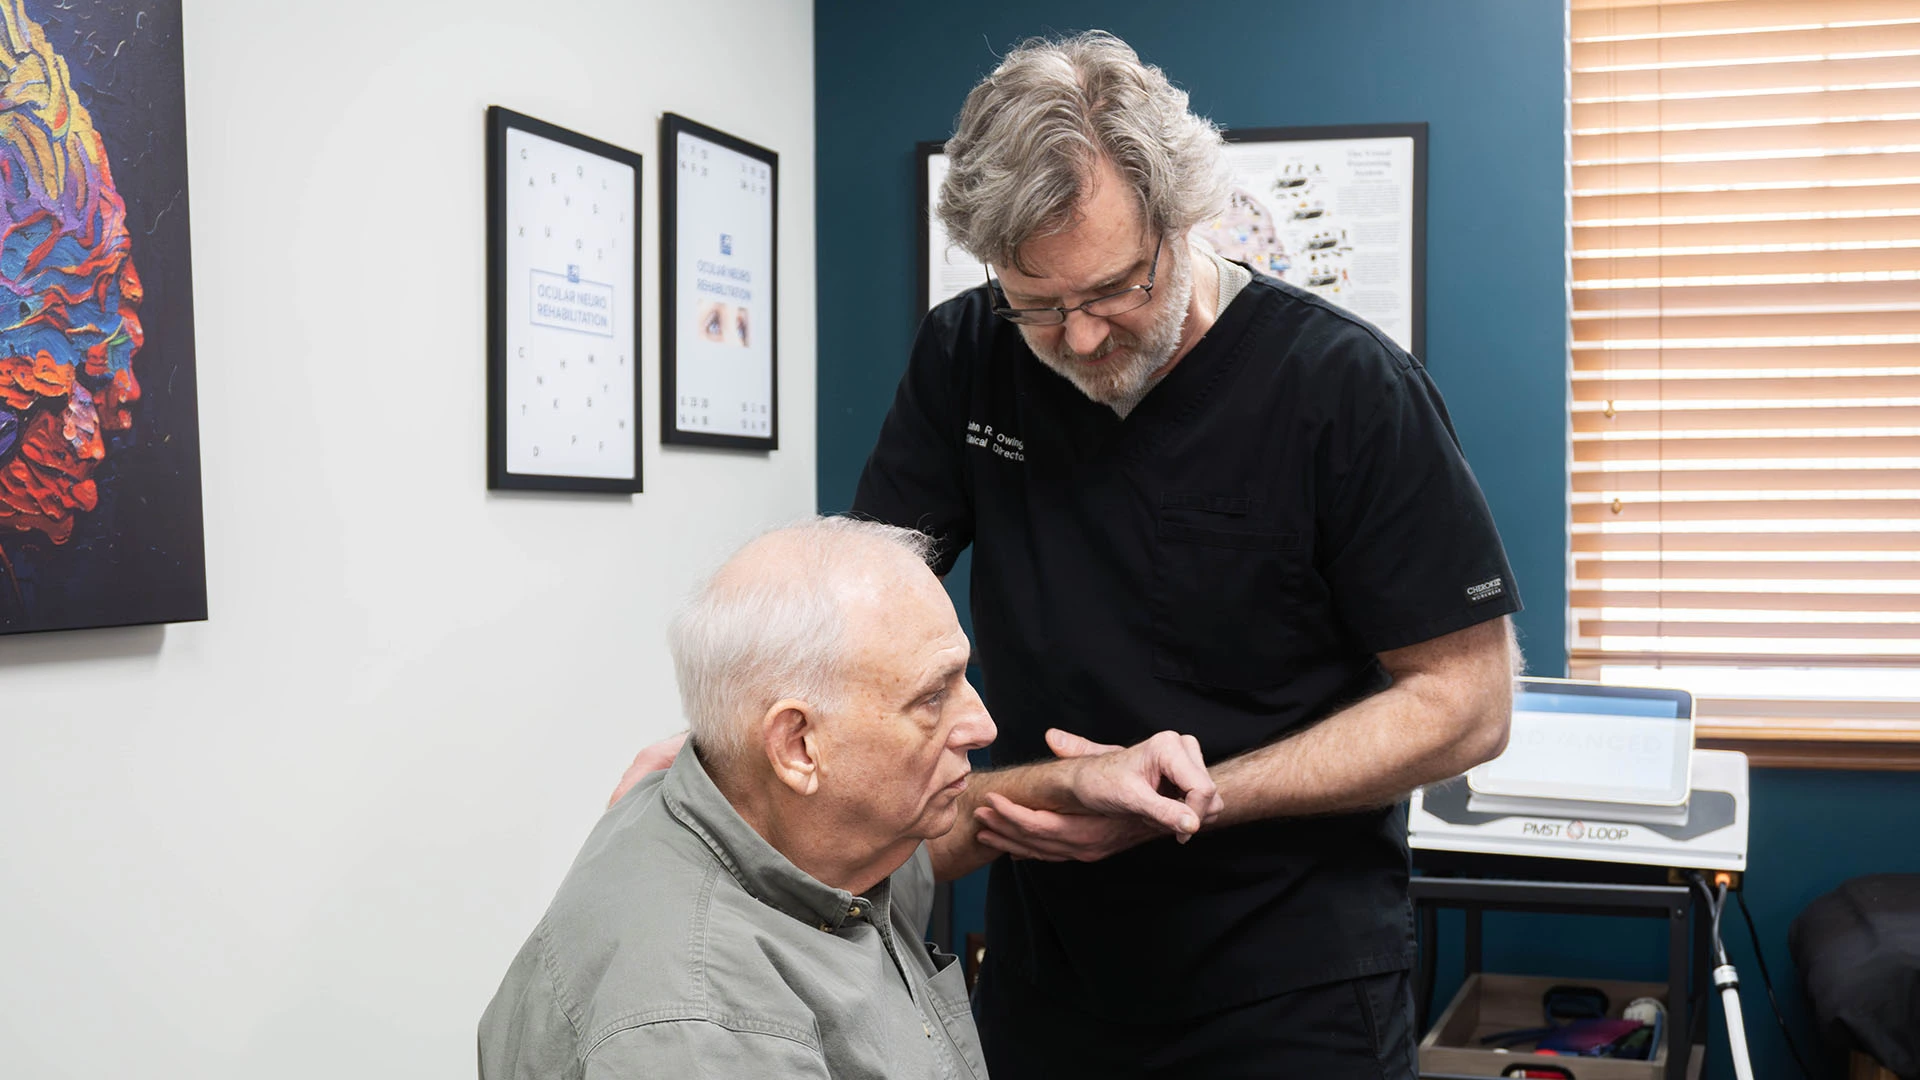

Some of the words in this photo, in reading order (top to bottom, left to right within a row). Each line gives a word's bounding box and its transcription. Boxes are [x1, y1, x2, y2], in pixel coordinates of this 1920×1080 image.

[538, 284, 576, 303] OCULAR
[577, 292, 607, 309] NEURO
[537, 303, 608, 327] REHABILITATION
[996, 433, 1024, 450] Owing
[992, 443, 1025, 461] Directo
[1523, 822, 1562, 837] PMST
[1588, 827, 1629, 840] LOOP
